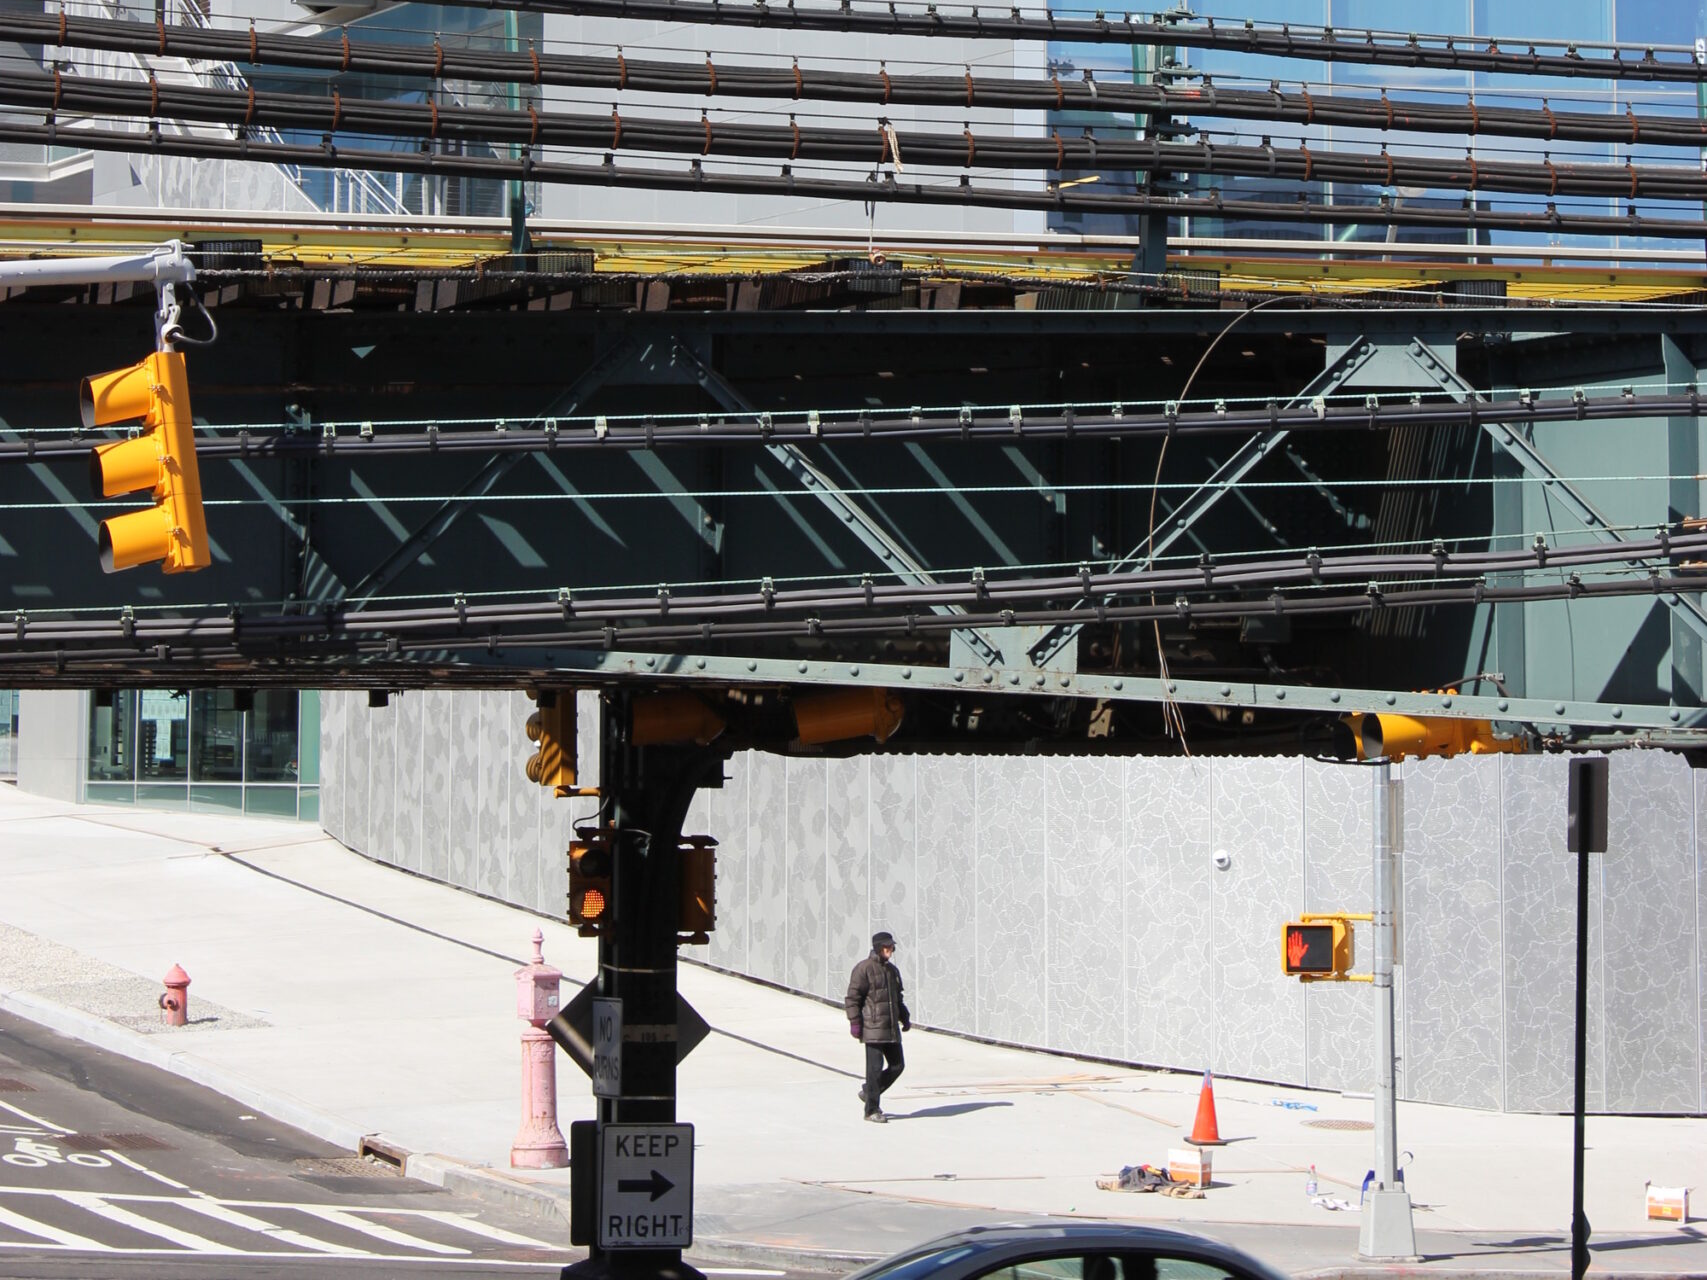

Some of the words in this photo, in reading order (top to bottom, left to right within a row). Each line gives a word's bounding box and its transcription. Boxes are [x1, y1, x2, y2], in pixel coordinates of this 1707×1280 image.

[600, 1016, 612, 1042] NO
[594, 1055, 619, 1080] TURNS
[616, 1135, 679, 1157] KEEP
[609, 1215, 682, 1237] RIGHT
